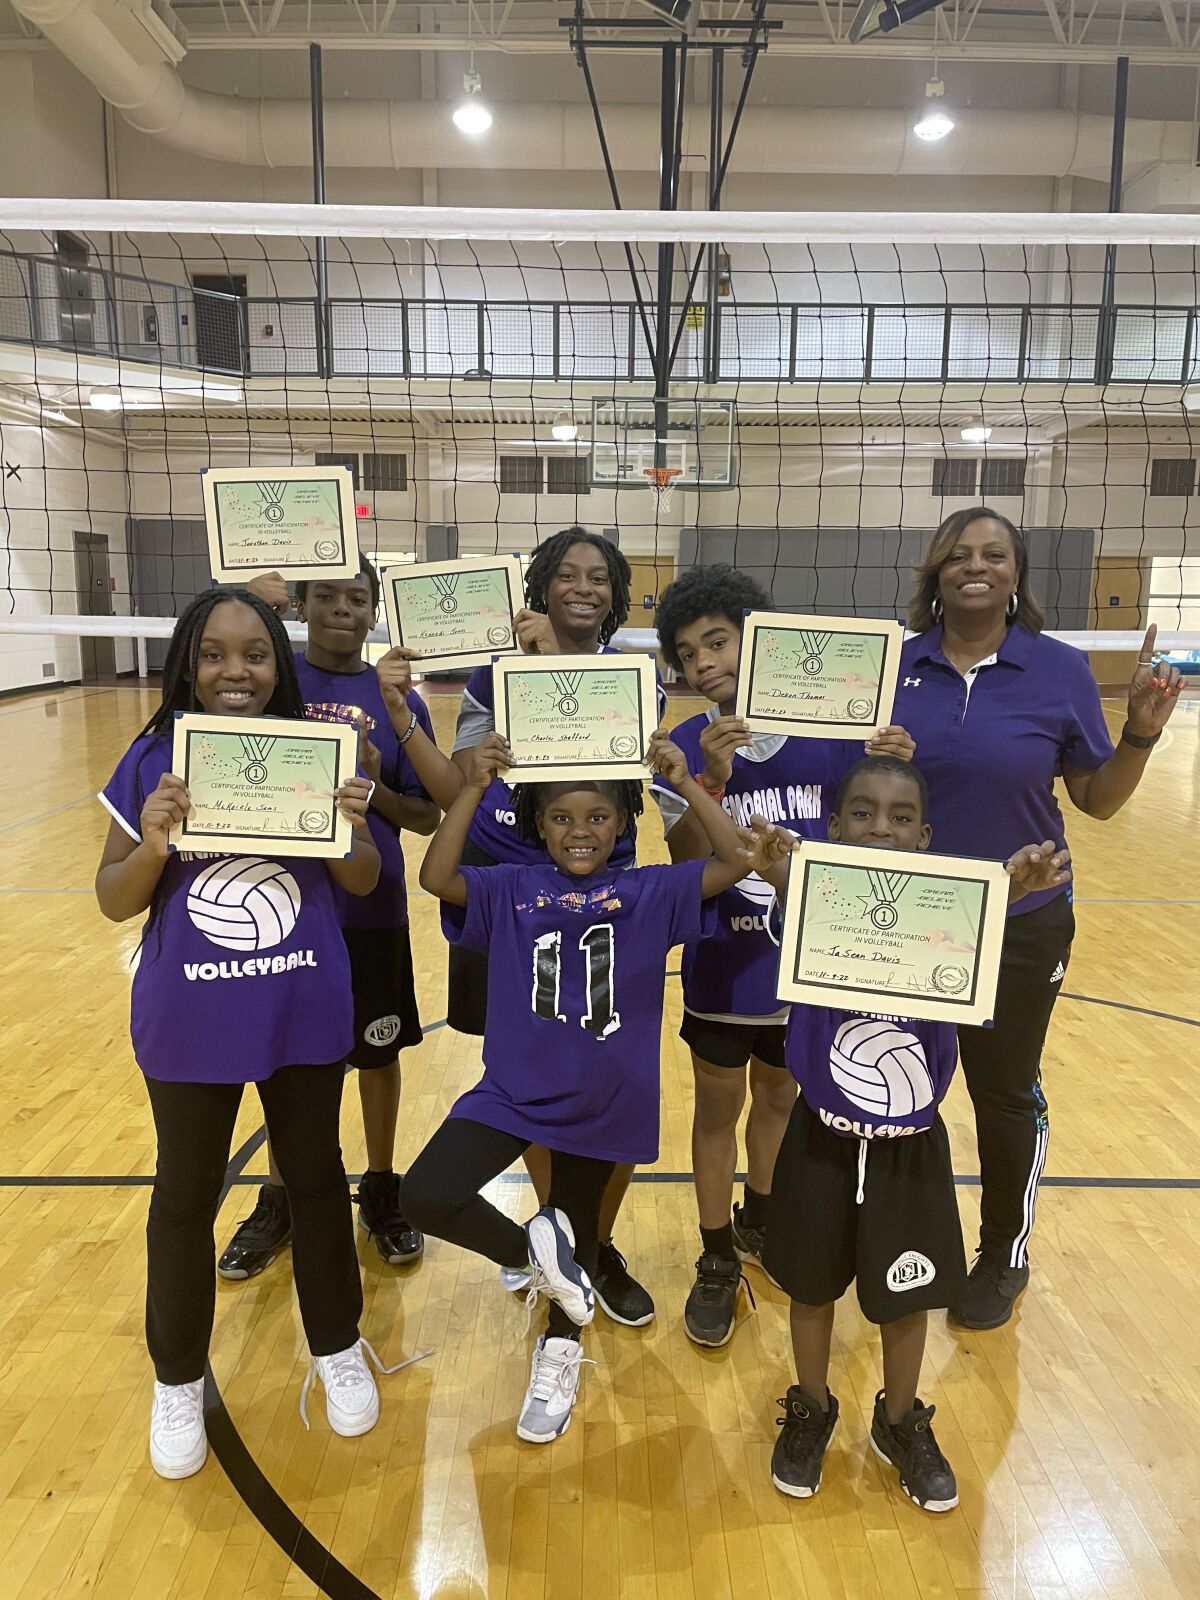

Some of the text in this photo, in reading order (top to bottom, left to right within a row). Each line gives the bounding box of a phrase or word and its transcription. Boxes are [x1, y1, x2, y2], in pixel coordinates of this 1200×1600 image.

[722, 785, 822, 826] EMORIAL PARK
[830, 925, 870, 935] CERTIFICATE
[881, 931, 930, 942] PARTICIPATION
[864, 937, 904, 948] VOLLEYBALL
[184, 950, 317, 980] VOLLEYBALL
[872, 952, 900, 964] Davis
